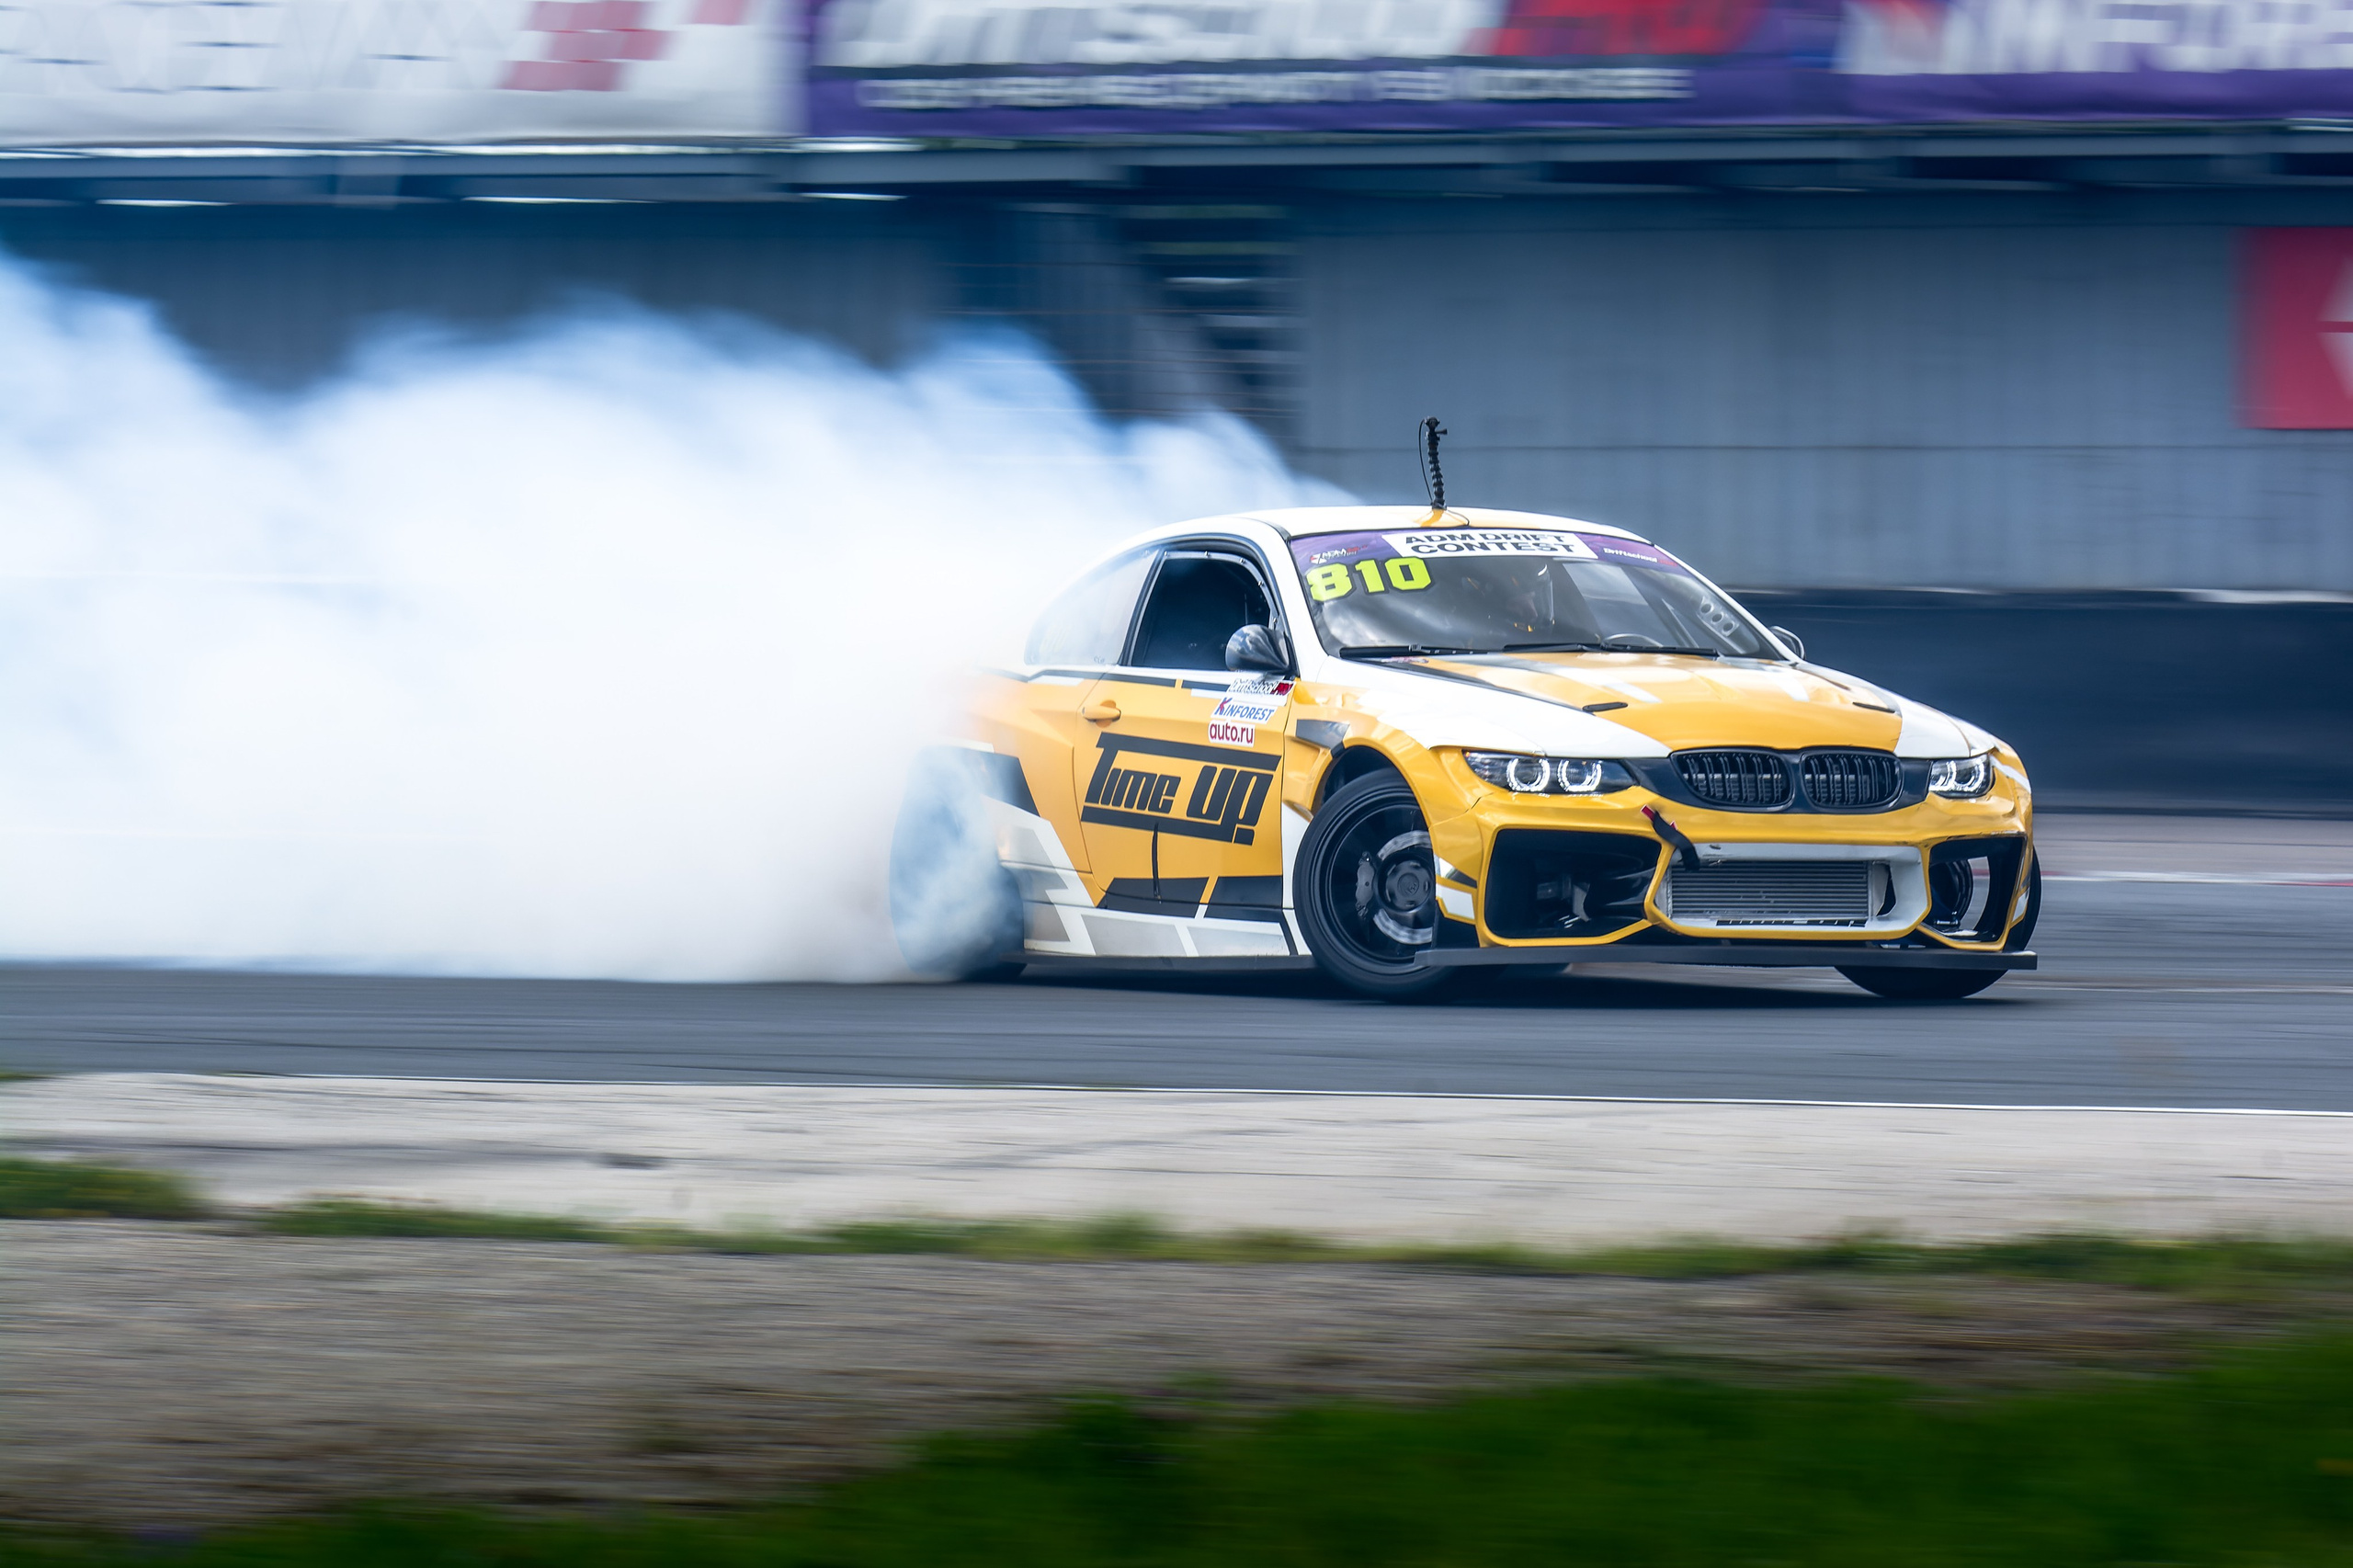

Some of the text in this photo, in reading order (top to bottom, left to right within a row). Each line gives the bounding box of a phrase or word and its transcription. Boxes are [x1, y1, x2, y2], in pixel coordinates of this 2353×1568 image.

[1405, 532, 1565, 544] ADM DRIFT
[1411, 542, 1577, 554] CONTEST
[1305, 555, 1433, 603] 810
[1214, 697, 1275, 722] KINFOREST
[1210, 722, 1254, 744] auto.ru
